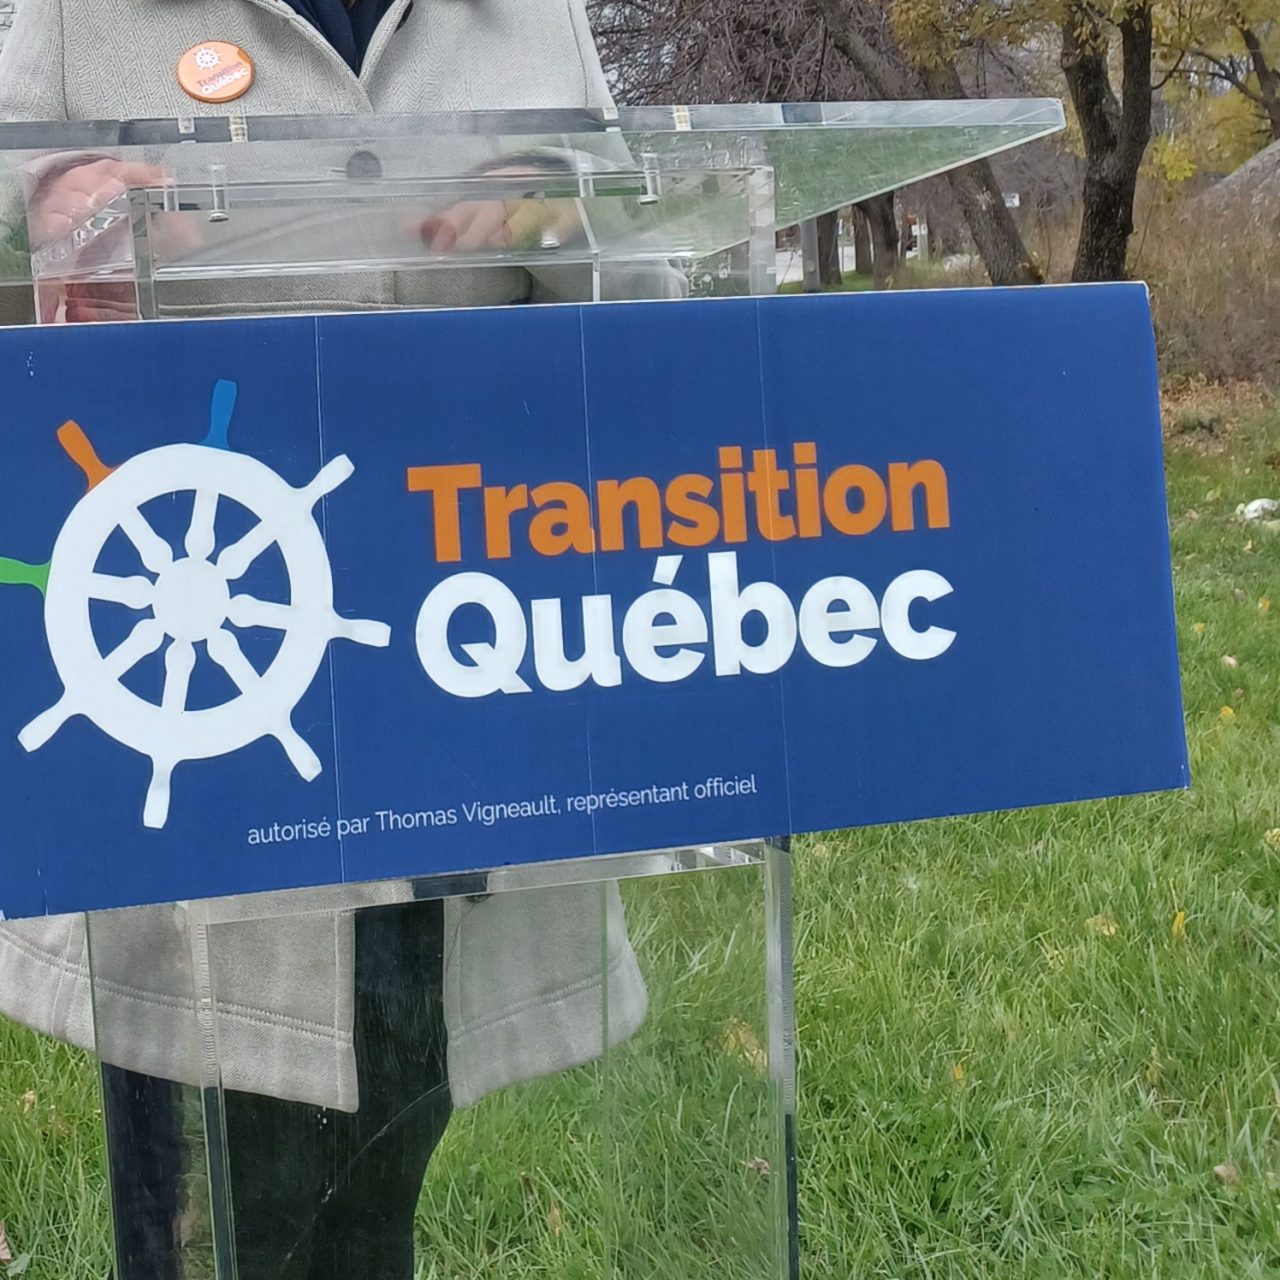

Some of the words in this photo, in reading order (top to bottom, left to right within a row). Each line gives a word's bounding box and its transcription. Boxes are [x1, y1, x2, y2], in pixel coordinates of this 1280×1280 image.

[407, 441, 950, 562] Transition
[415, 551, 957, 698] Québec
[248, 816, 331, 845] autorisé
[336, 817, 370, 840] par
[375, 806, 457, 831] Thomas
[462, 795, 562, 825] Vigneault,
[566, 781, 690, 815] représentant
[694, 774, 757, 800] officiel
